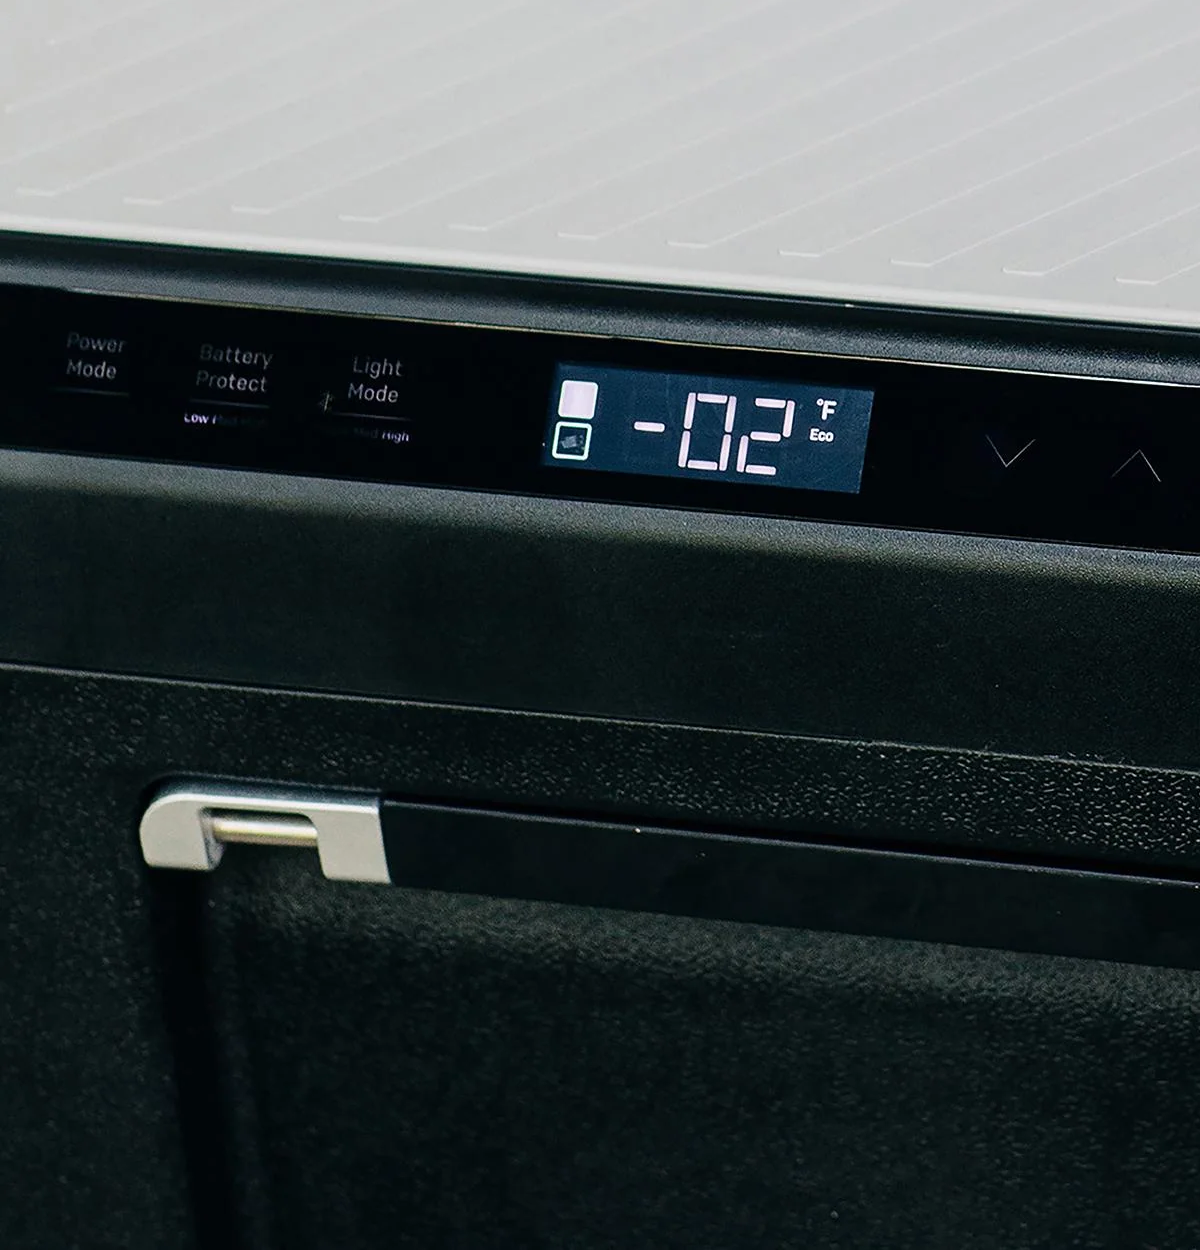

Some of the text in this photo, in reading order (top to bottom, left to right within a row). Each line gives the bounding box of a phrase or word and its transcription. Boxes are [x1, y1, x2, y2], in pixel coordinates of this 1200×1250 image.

[66, 330, 128, 353] Power
[199, 342, 275, 370] Battery
[352, 355, 404, 379] Light
[65, 358, 118, 380] Mode
[195, 369, 268, 393] Protect
[347, 382, 399, 404] Mode
[634, 392, 795, 476] -02
[809, 428, 834, 443] Eco
